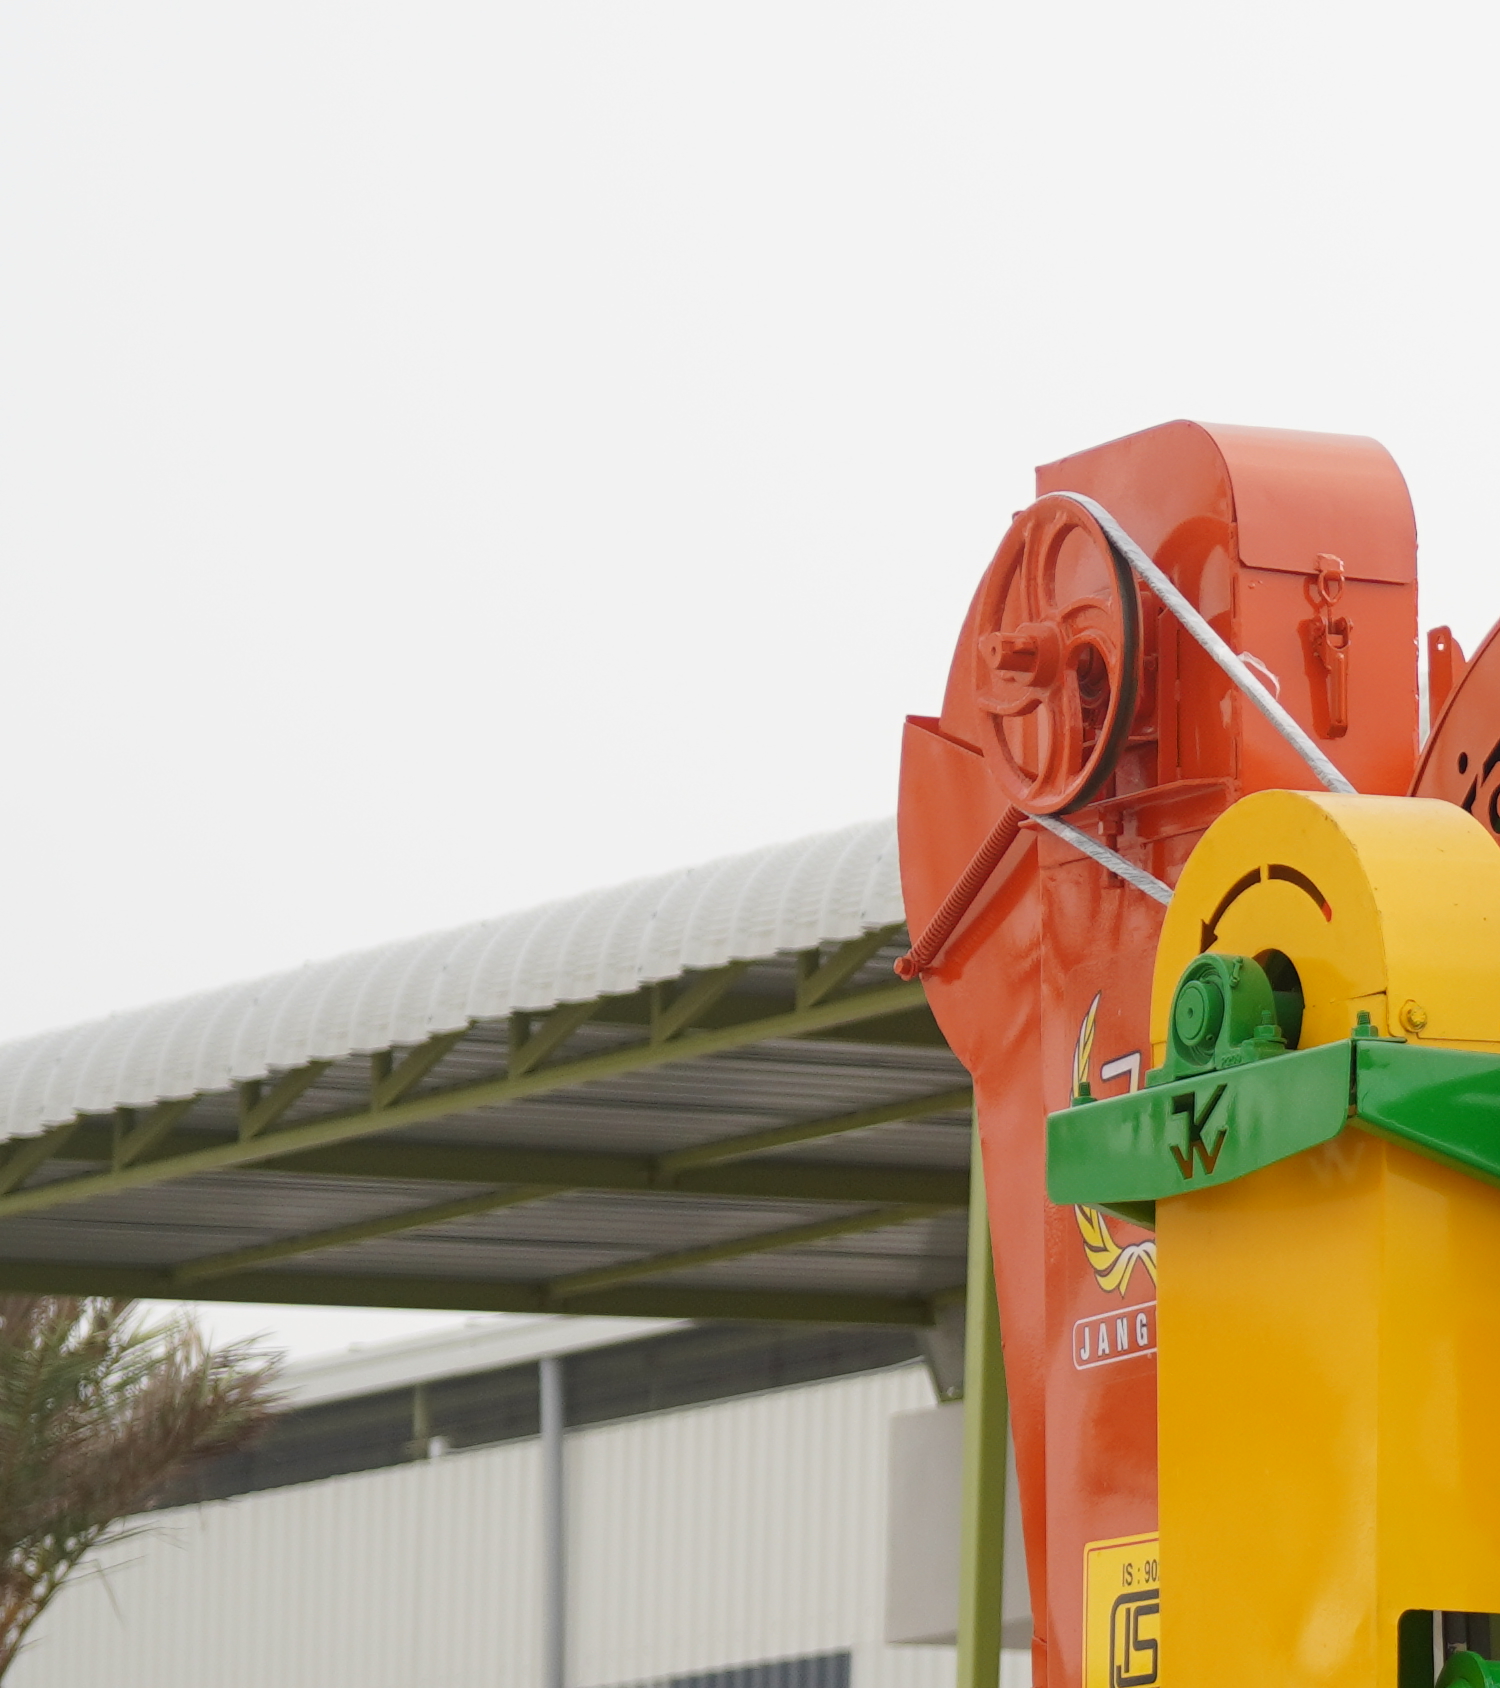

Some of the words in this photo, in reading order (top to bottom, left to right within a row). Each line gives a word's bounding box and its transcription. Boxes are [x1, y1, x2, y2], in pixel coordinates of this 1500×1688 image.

[1080, 1311, 1157, 1361] JANG
[1122, 1562, 1133, 1587] IS
[1144, 1558, 1160, 1584] 90
